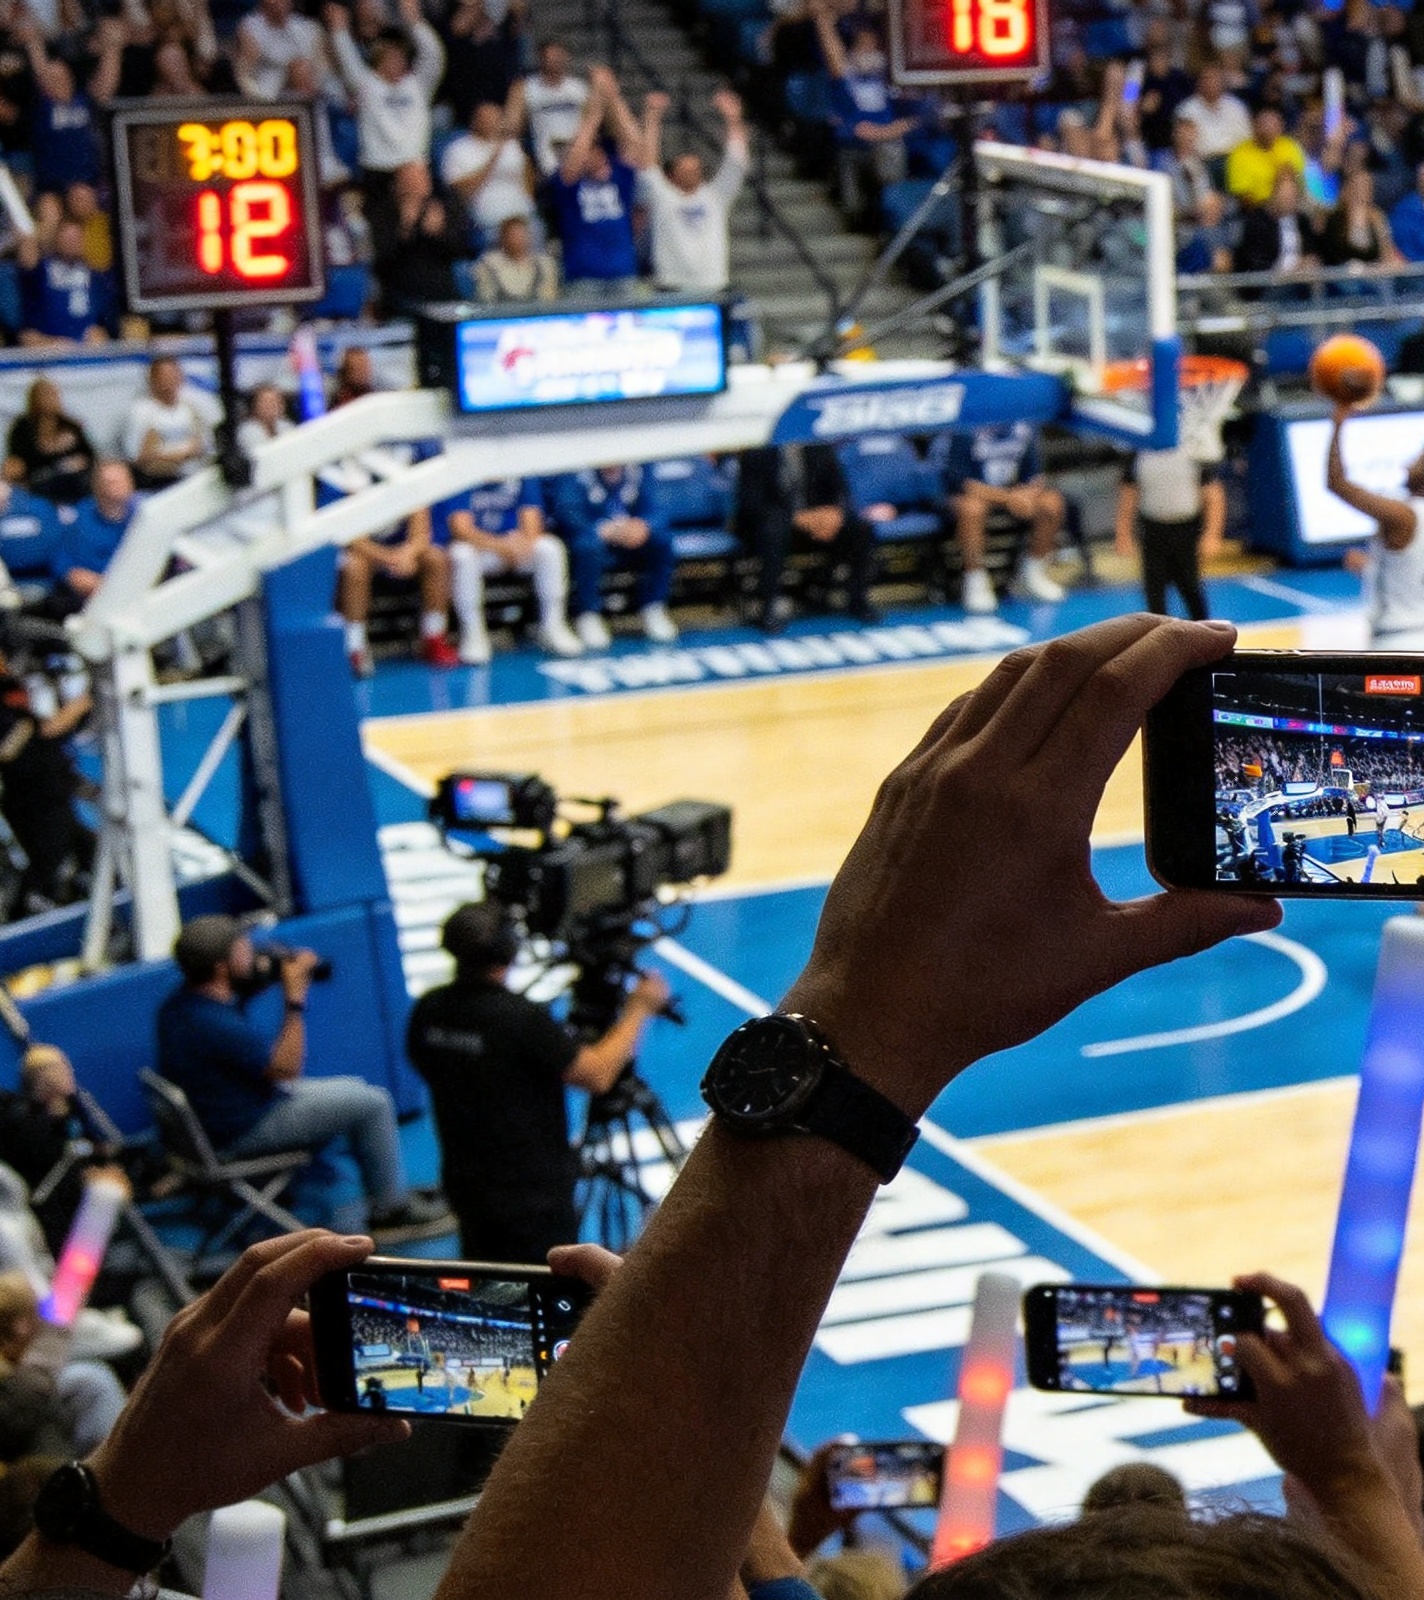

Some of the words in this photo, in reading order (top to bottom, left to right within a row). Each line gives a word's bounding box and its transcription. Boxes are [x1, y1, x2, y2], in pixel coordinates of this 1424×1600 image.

[951, 0, 1030, 55] 18
[177, 119, 299, 181] 7:00
[197, 183, 291, 278] 12
